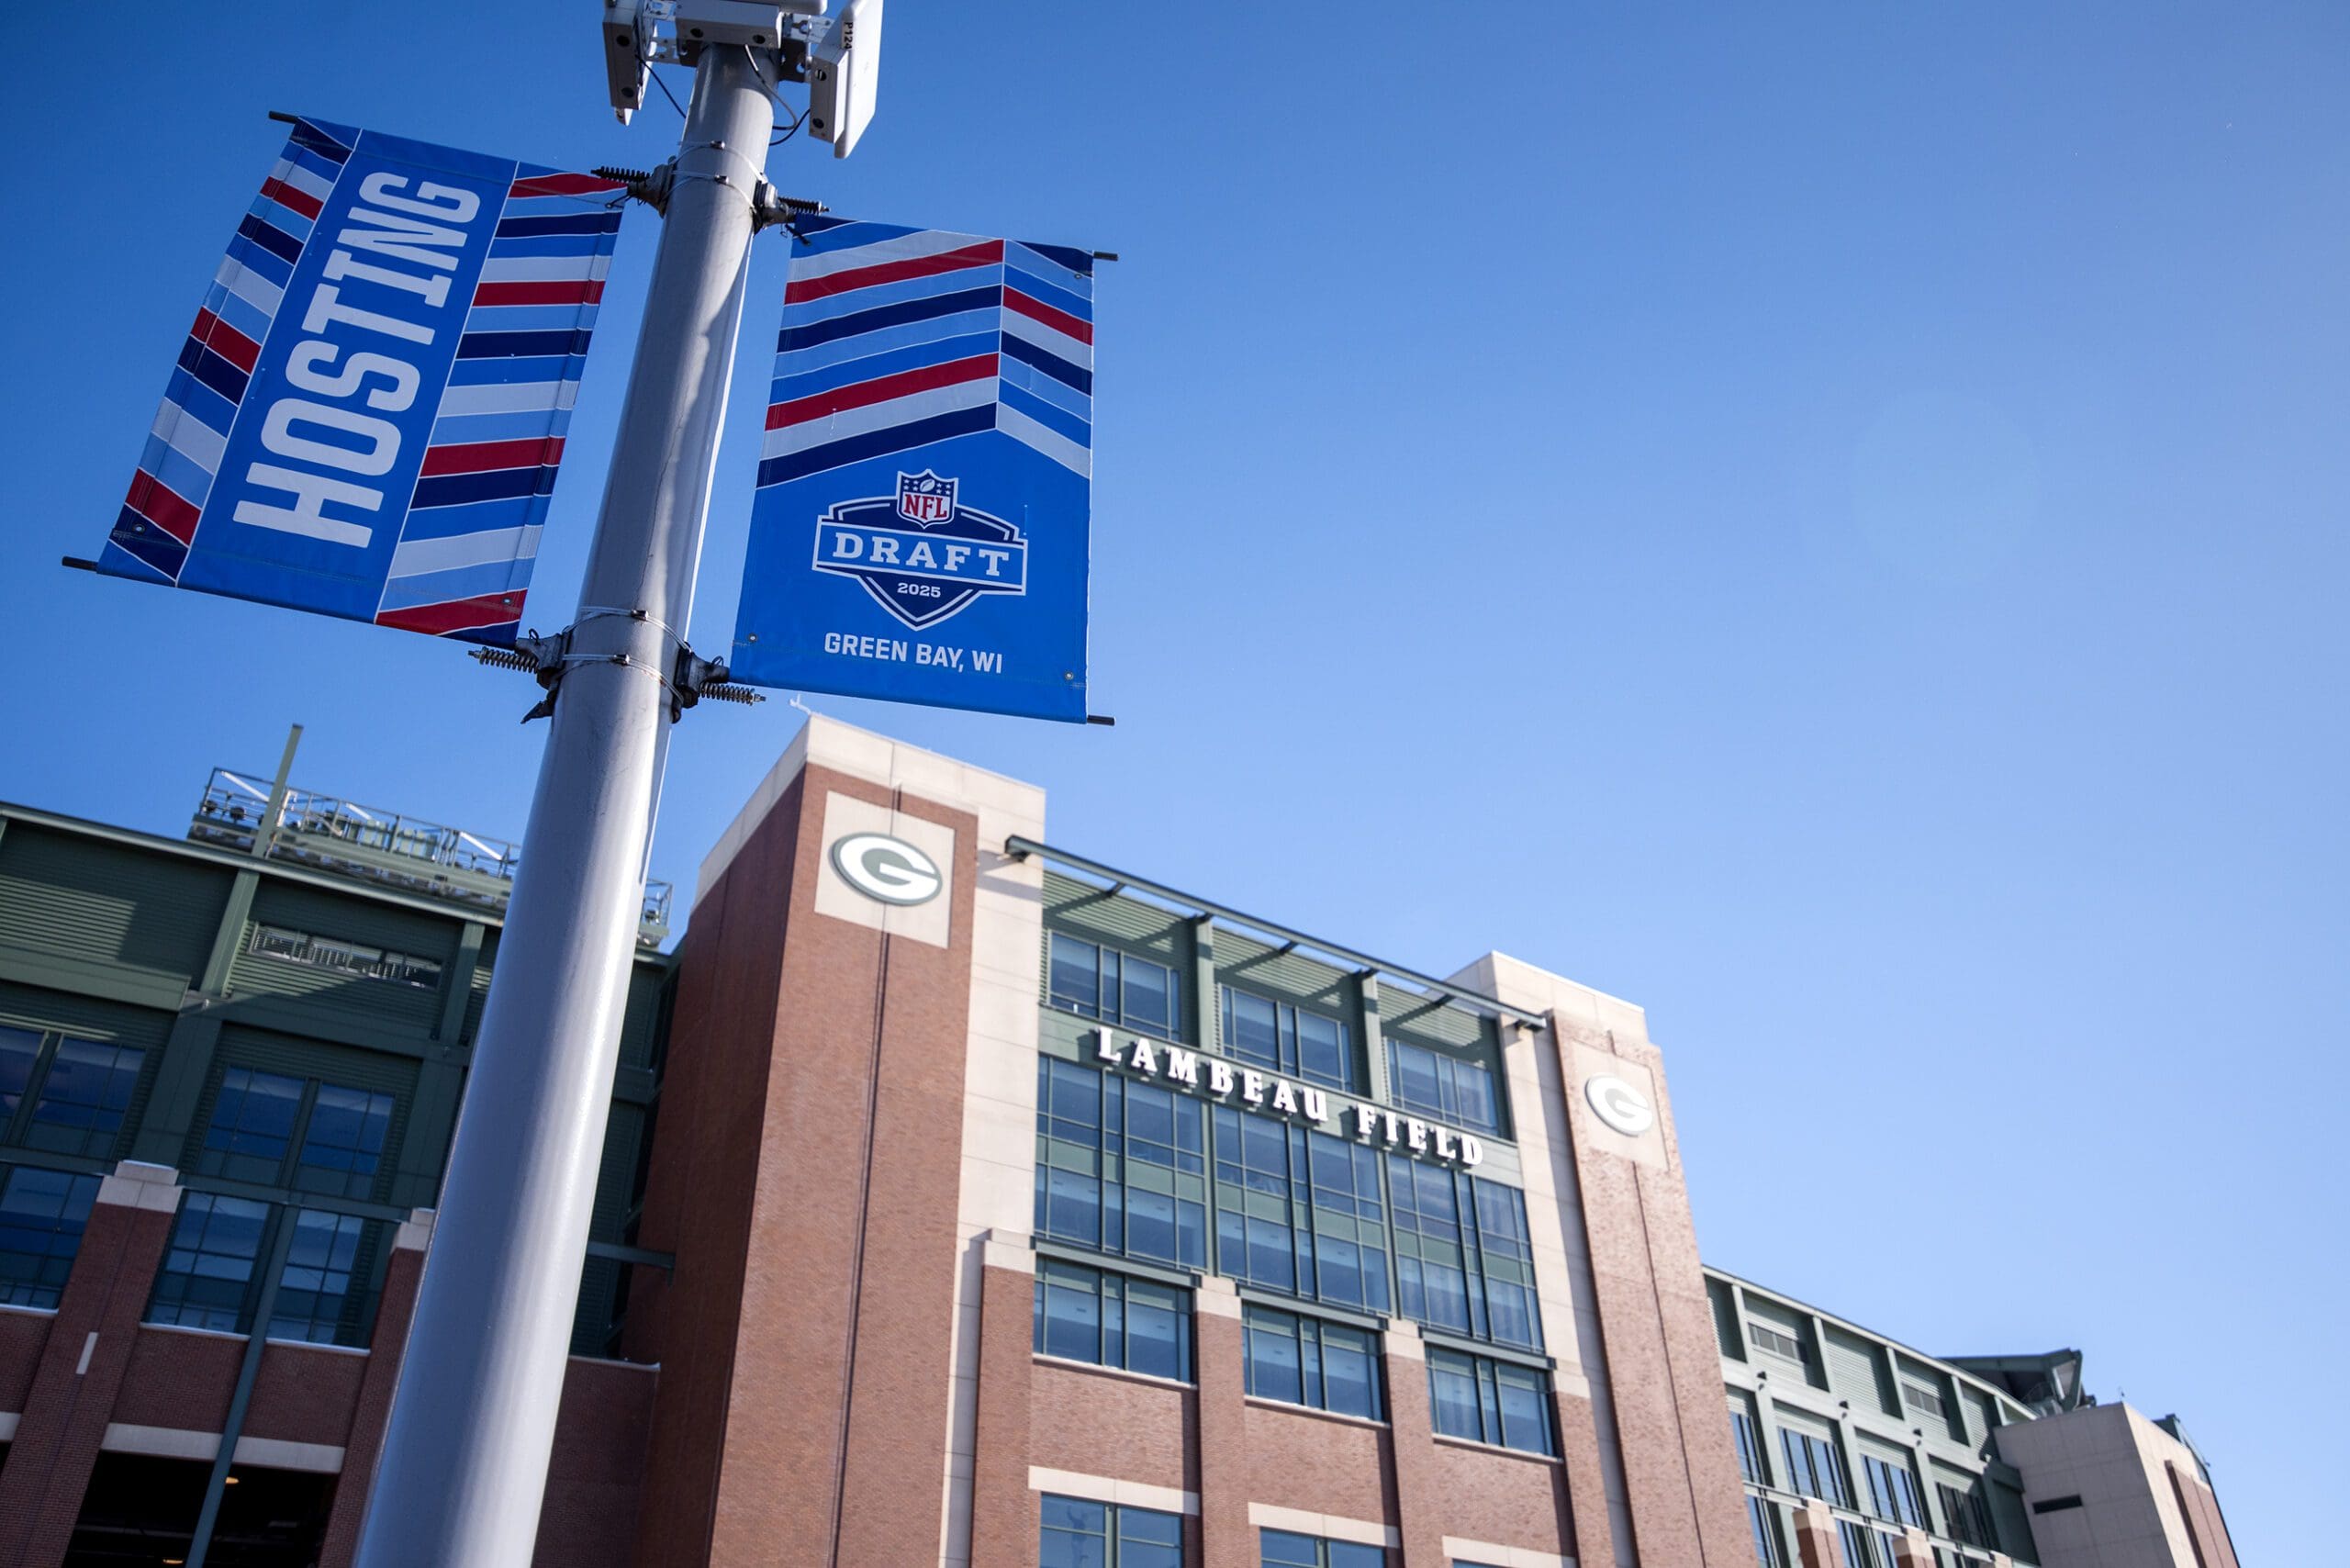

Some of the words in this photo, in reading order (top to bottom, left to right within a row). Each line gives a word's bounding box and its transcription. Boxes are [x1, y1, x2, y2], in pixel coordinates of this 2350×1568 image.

[232, 172, 481, 548] HOSTING
[902, 494, 947, 520] NFL
[833, 532, 1009, 577] DRAFT
[897, 582, 941, 598] 2025
[824, 632, 907, 662] GREEN
[915, 643, 963, 673] BAY,
[971, 650, 1002, 674] WI
[839, 835, 938, 901] G
[1095, 1025, 1328, 1123] LAMBEAU
[1354, 1102, 1484, 1166] FIELD
[1589, 1076, 1653, 1132] G
